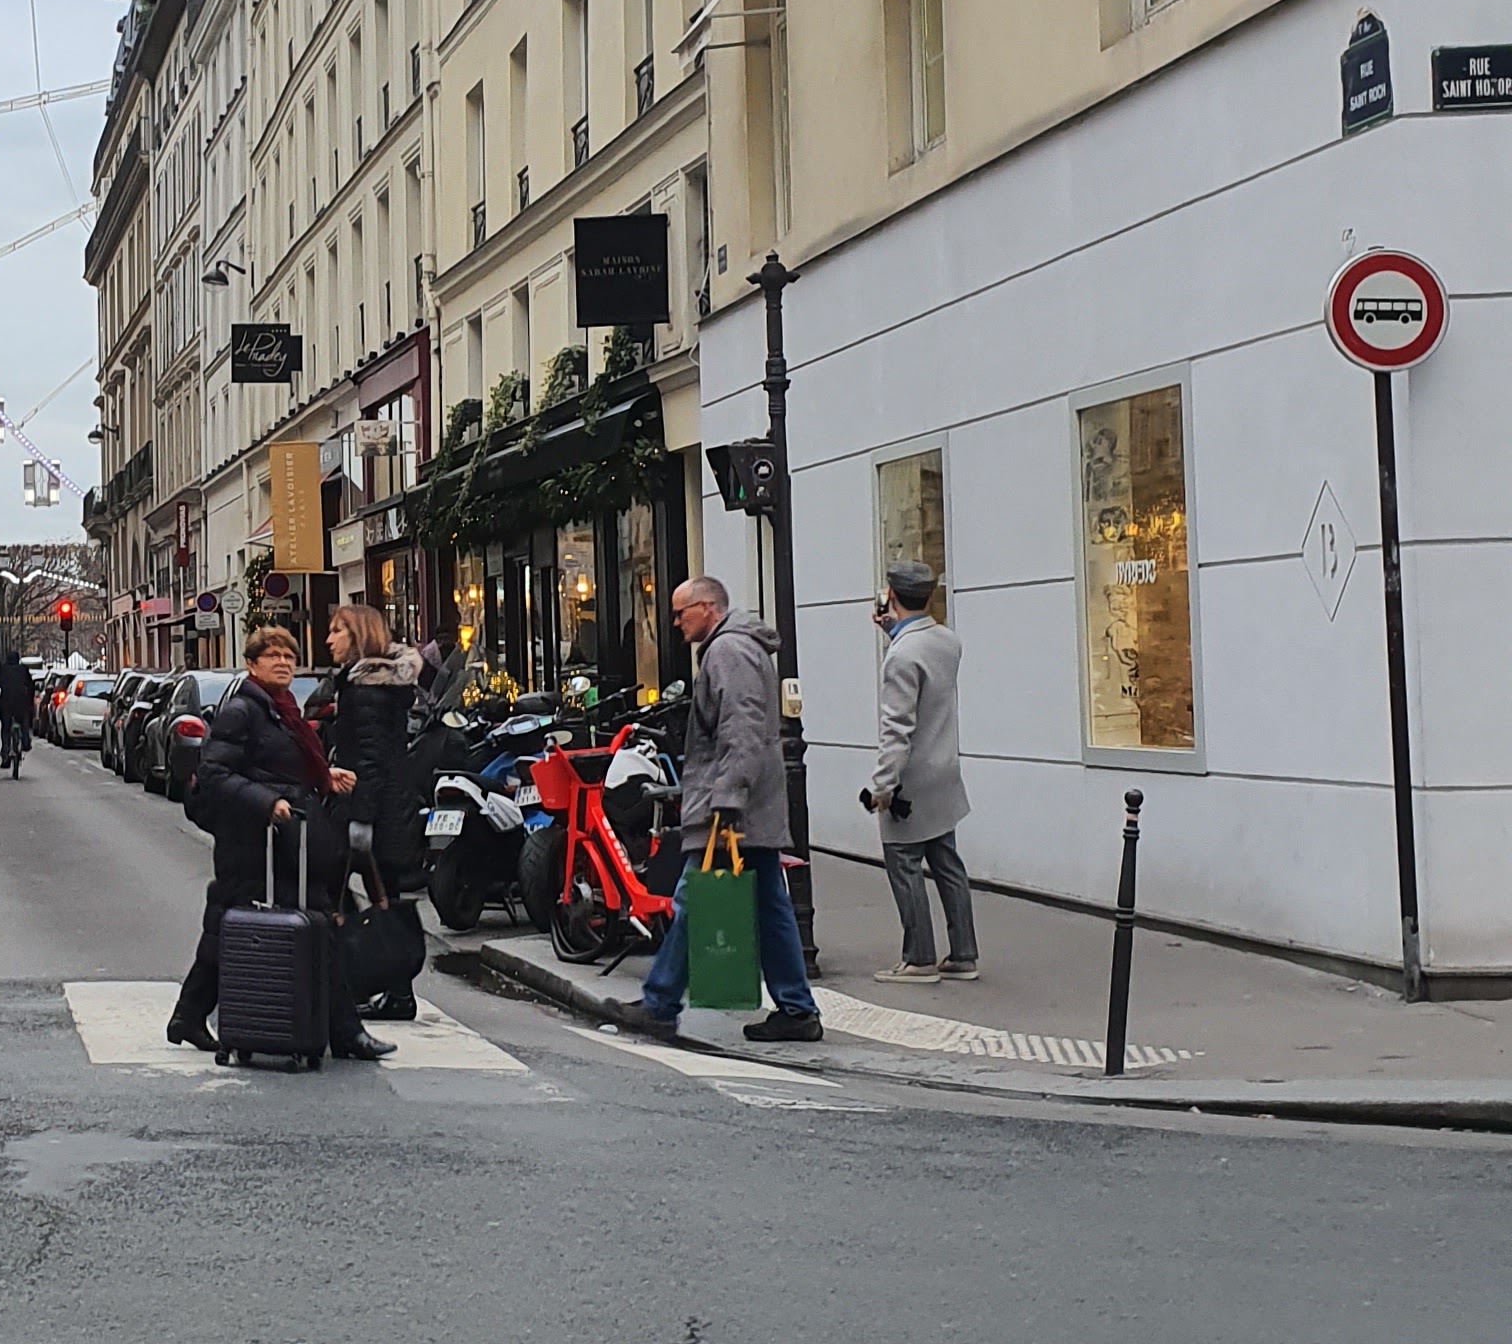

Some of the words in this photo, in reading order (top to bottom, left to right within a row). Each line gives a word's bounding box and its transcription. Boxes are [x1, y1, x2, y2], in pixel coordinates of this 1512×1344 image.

[1359, 59, 1374, 79] RUE
[1469, 57, 1491, 76] RUE
[1349, 90, 1368, 112] SAINT
[1368, 82, 1387, 104] ROCH
[1442, 79, 1472, 98] SAINT
[602, 255, 641, 265] MAISON
[286, 452, 296, 513] LAVOISIER
[288, 517, 298, 566] ATELIER
